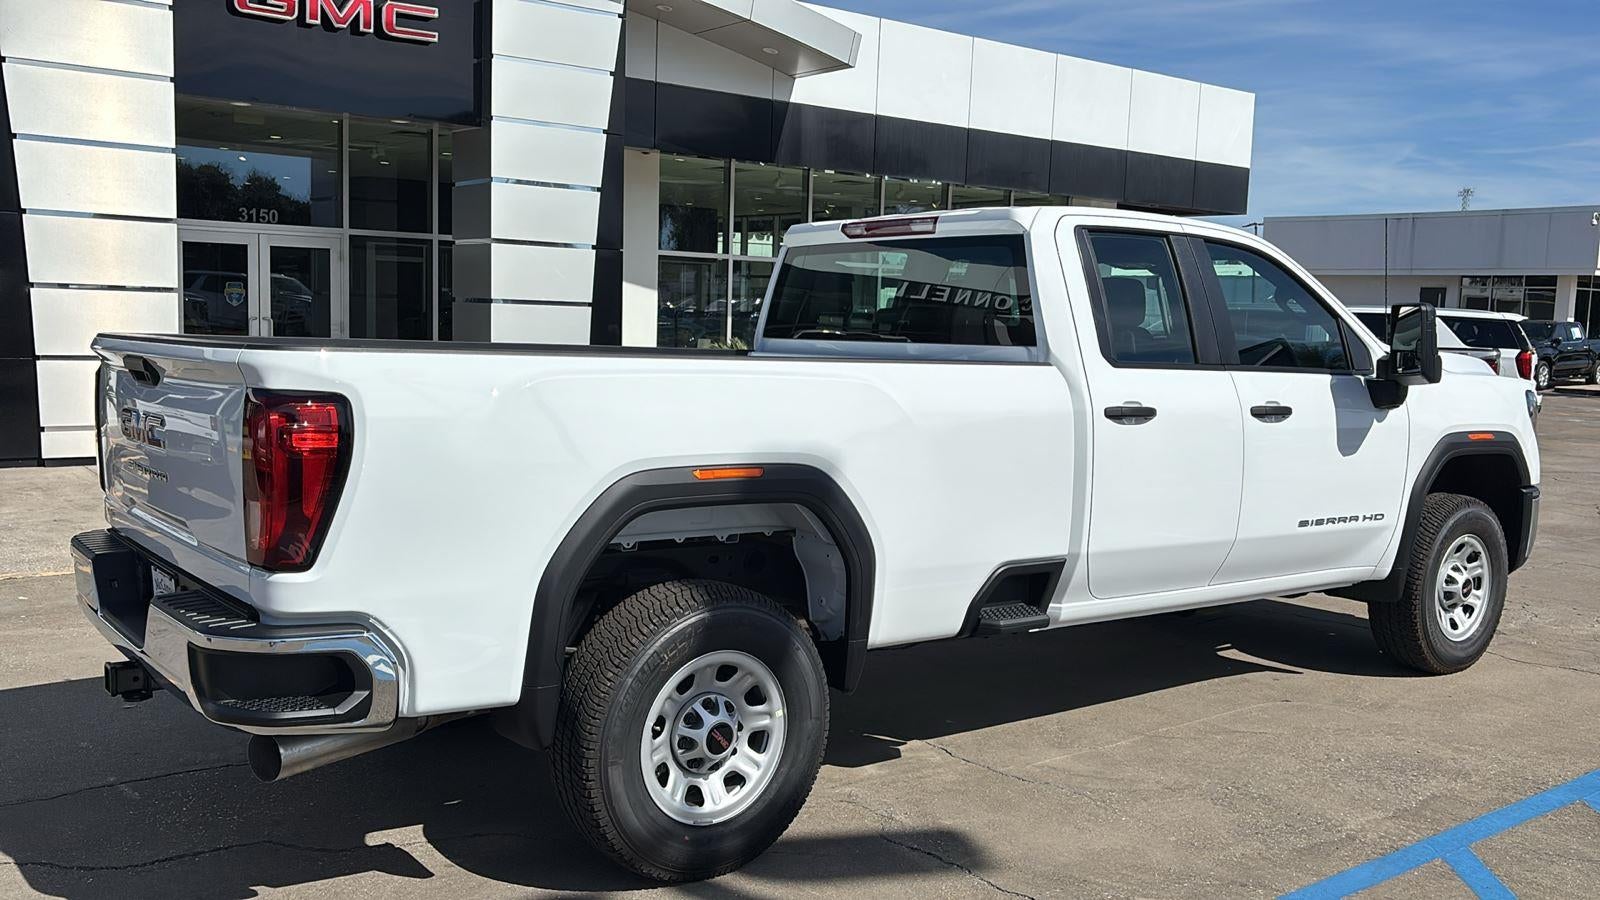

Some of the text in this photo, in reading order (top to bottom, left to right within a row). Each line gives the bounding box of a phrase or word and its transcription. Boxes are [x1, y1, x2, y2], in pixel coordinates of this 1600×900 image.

[239, 207, 279, 224] 3150
[121, 407, 167, 449] GMC
[1298, 513, 1385, 528] SIERRA HD
